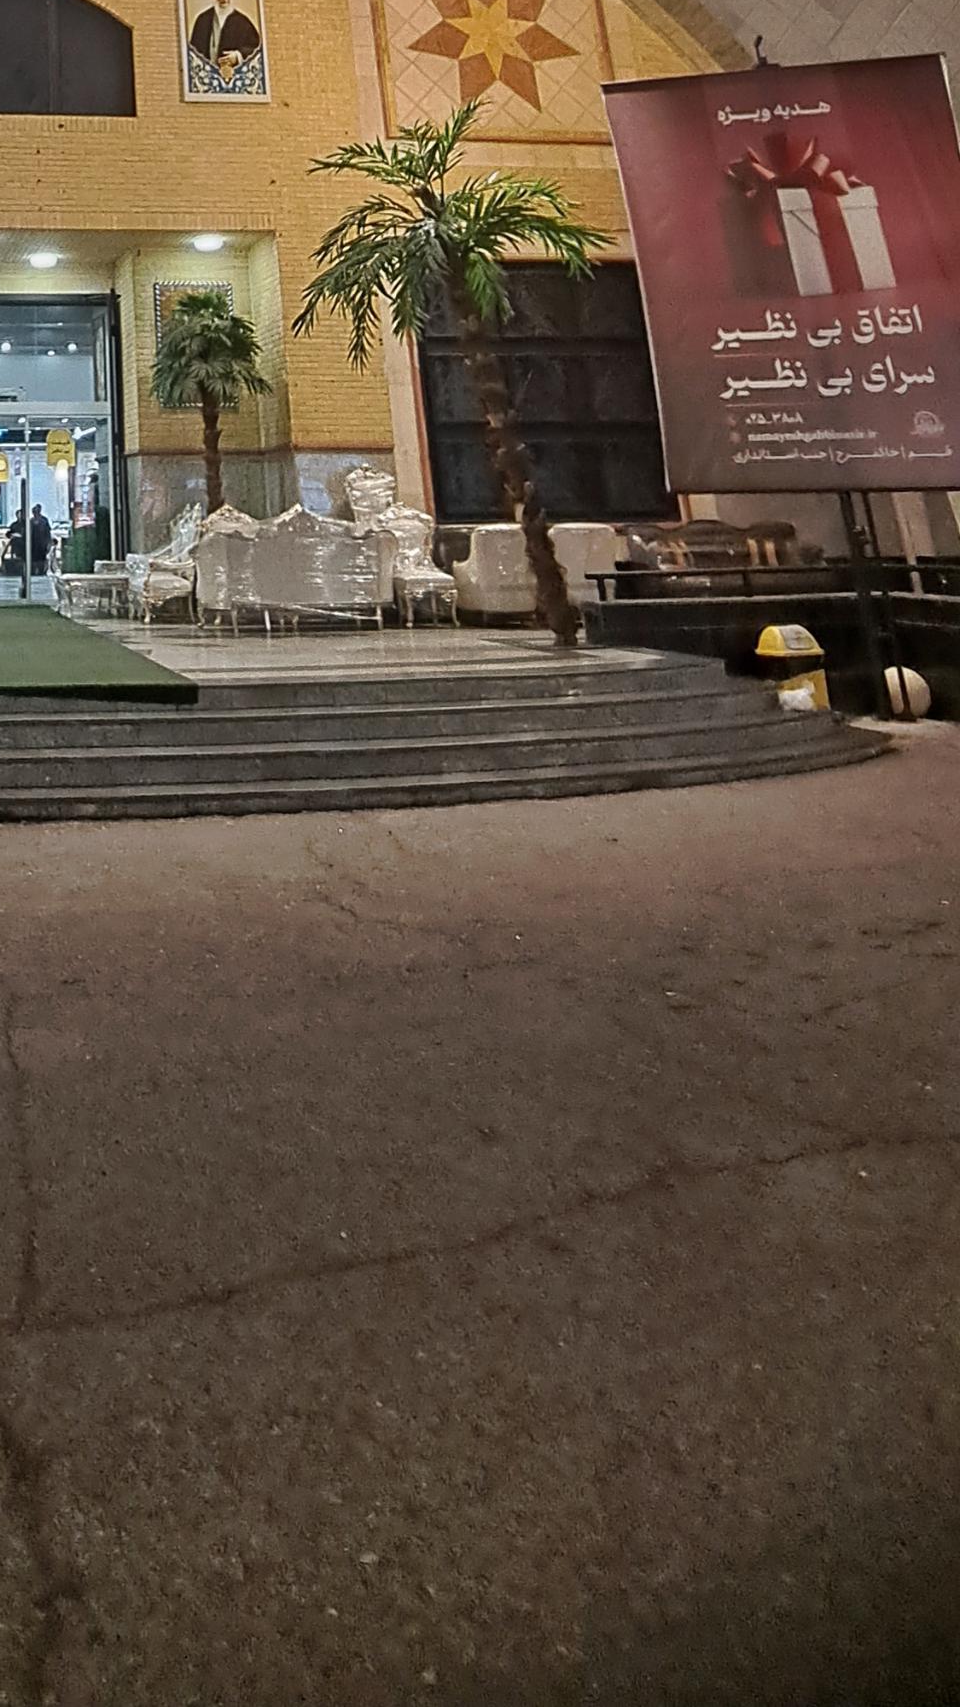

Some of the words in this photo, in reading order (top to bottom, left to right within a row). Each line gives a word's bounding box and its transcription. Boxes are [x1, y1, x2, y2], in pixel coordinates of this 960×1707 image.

[717, 105, 772, 126] ویژه
[773, 100, 832, 120] هدیه
[711, 308, 797, 351] نظیر
[806, 316, 842, 348] بی
[851, 303, 924, 345] اتفاق
[718, 357, 808, 400] نظیر
[816, 366, 853, 398] بی
[861, 354, 936, 395] سرای
